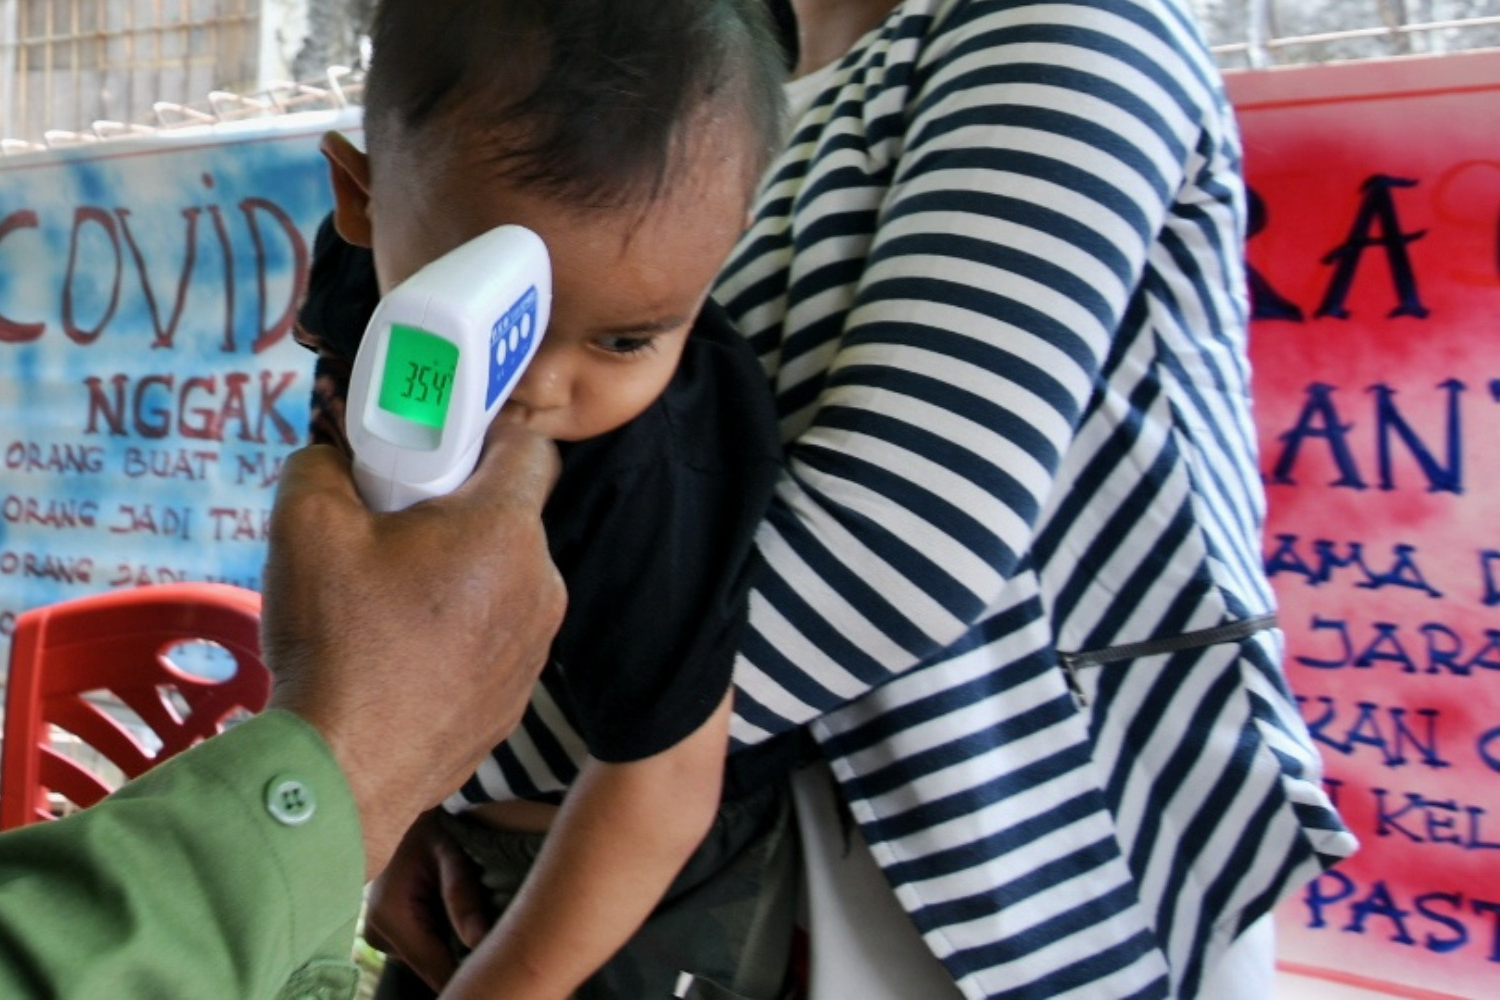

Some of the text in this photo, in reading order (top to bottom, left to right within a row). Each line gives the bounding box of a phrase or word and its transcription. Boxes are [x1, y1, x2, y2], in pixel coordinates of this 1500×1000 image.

[83, 369, 299, 446] NGGAK
[5, 441, 103, 473] ORANG
[124, 448, 218, 480] BUAT
[2, 494, 99, 530] ORANG
[109, 504, 191, 541] JADI
[0, 550, 94, 584] ORANG
[1295, 614, 1500, 676] JARA
